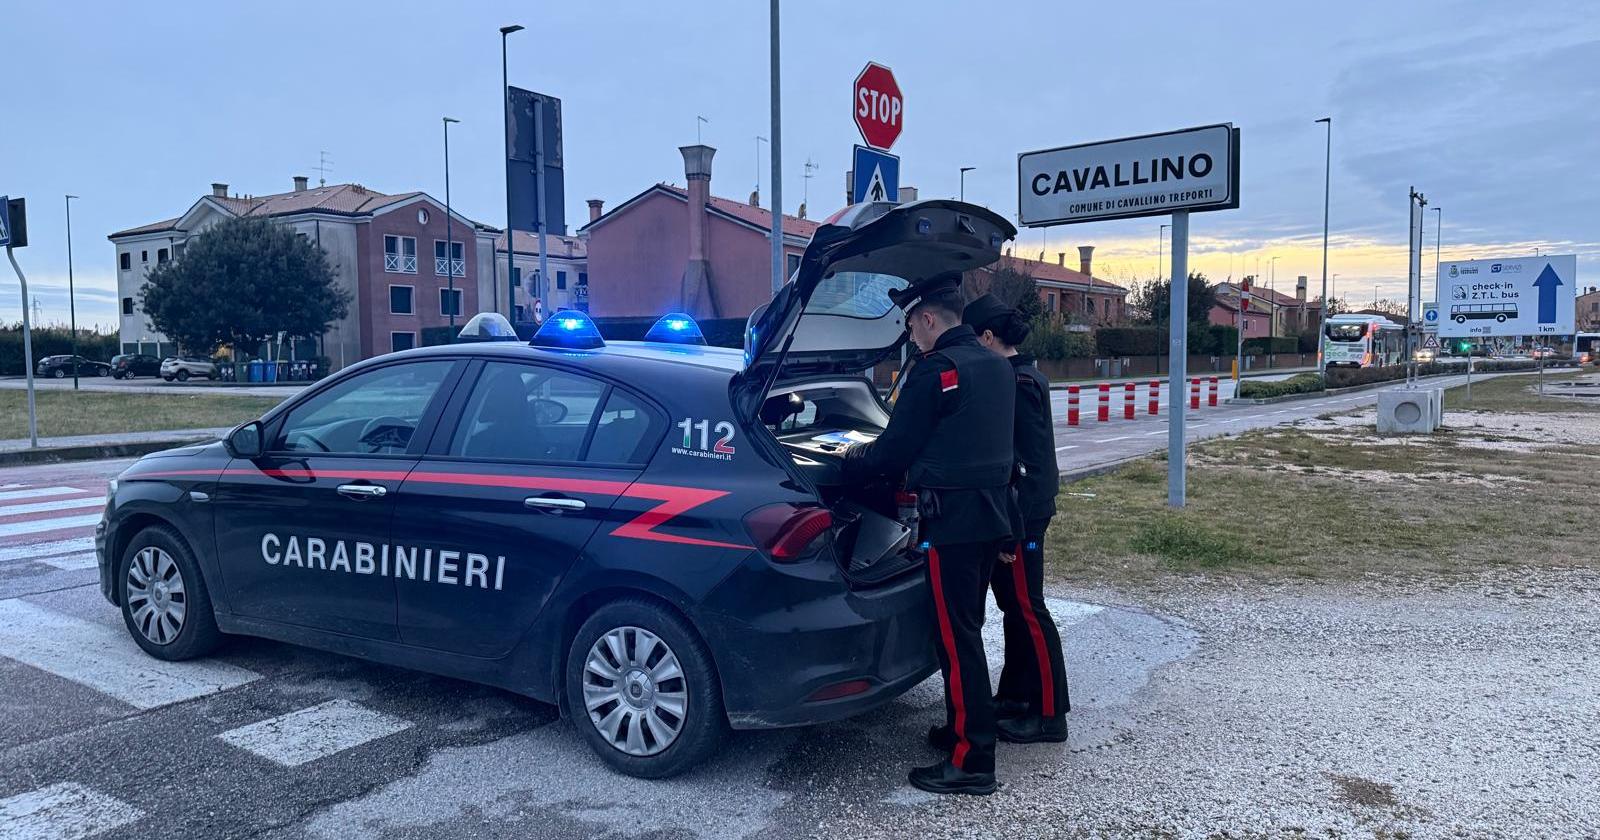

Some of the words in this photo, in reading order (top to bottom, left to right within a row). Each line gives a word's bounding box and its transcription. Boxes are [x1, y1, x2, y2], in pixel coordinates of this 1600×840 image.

[859, 87, 901, 126] STOP
[1031, 153, 1213, 196] CAVALLINO
[1069, 201, 1103, 213] COMUNE
[1106, 199, 1115, 210] DI
[1117, 194, 1166, 209] CAVALLINO
[1169, 189, 1213, 203] TREPORTI
[1472, 282, 1513, 290] check-in
[1472, 292, 1499, 300] Z.T.L.
[1502, 291, 1520, 299] bus
[677, 417, 736, 454] 112
[671, 447, 732, 461] www.carabinieri.it
[261, 533, 506, 591] CARABINIERI
